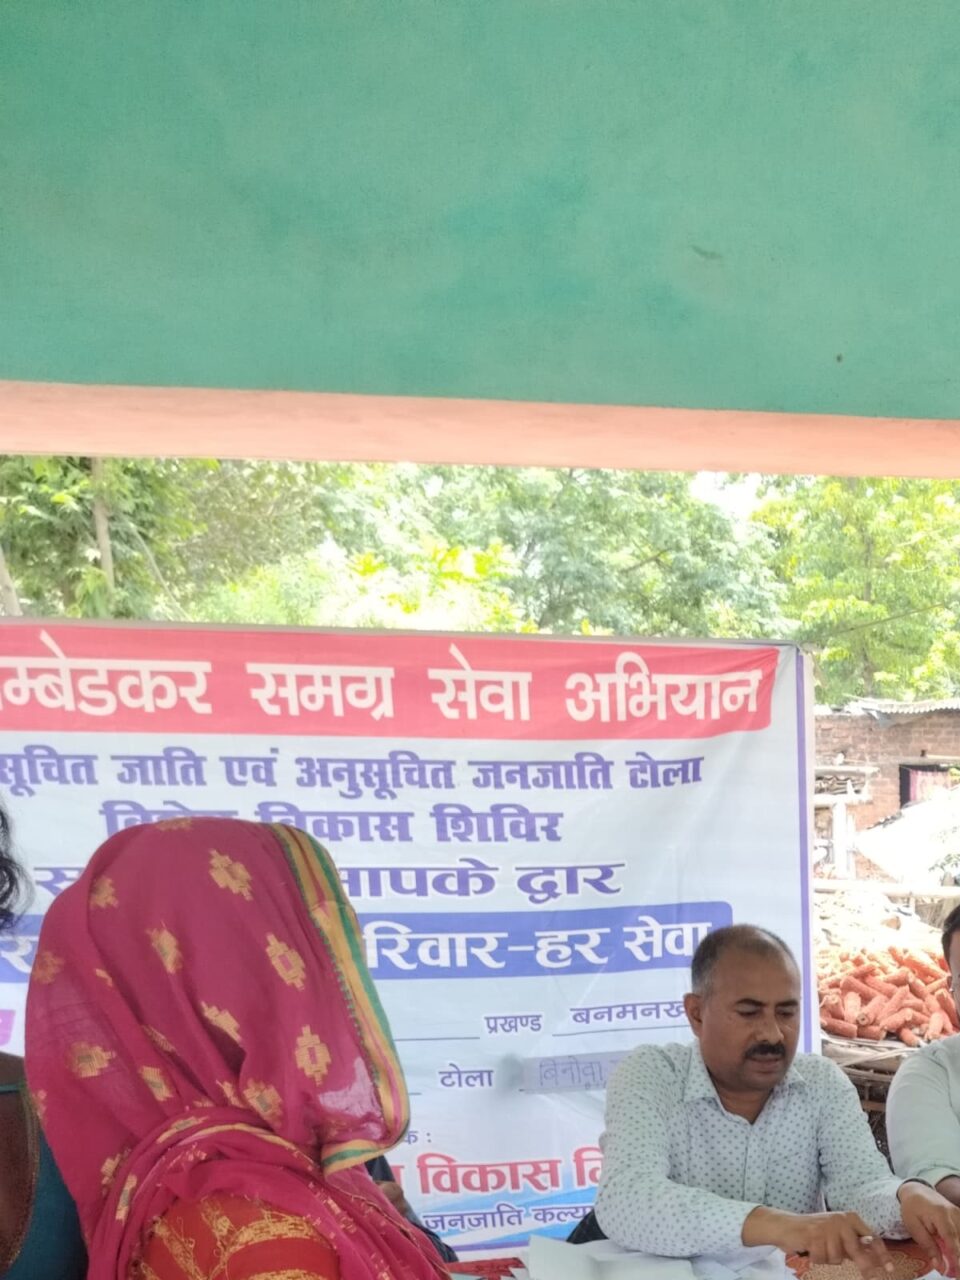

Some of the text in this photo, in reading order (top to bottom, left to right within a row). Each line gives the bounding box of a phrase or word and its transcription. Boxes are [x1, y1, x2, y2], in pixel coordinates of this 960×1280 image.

[0, 629, 763, 723] म्बेडकर समग्र सेवा अभियान
[110, 746, 207, 787] जाति
[219, 747, 279, 788] एवं
[295, 750, 456, 801] अनुसूचित
[468, 752, 614, 791] जनजाति
[625, 752, 705, 789] टोला
[430, 802, 564, 843] शिविर
[515, 862, 626, 903] द्वार
[362, 919, 611, 972] रिवार-हर
[623, 916, 713, 962] सेवा
[484, 1001, 686, 1034] प्रखण्ड बनमनख
[438, 1063, 494, 1088] टोला
[417, 1152, 562, 1195] विकास
[422, 1203, 523, 1232] जनजाति
